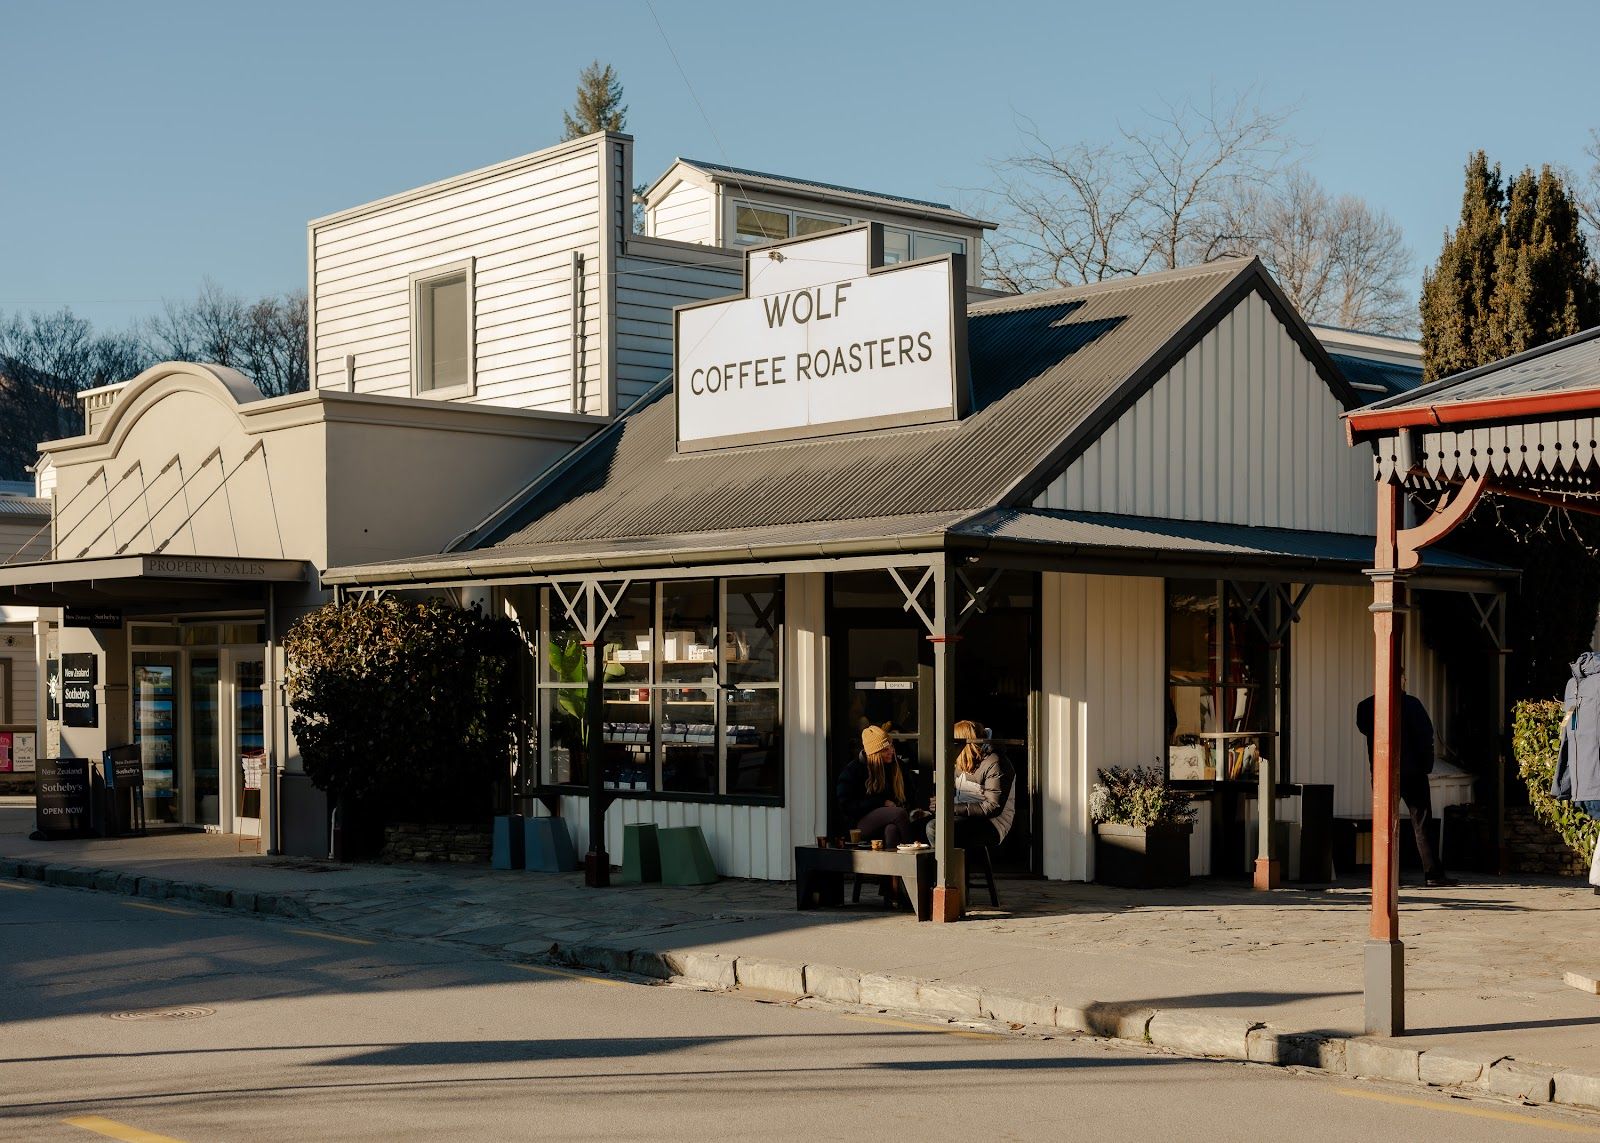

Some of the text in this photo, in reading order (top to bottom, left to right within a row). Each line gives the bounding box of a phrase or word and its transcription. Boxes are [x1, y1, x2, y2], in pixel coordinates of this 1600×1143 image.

[763, 282, 852, 329] WOLF
[691, 331, 932, 396] COFFEE ROASTERS
[149, 559, 265, 575] PROPERTY SALES
[64, 668, 90, 678] New Zealand
[64, 687, 90, 702] Sotheby's
[41, 767, 83, 776] New Zealand
[41, 782, 83, 794] Sotheby's
[42, 806, 84, 815] OPEN NOW
